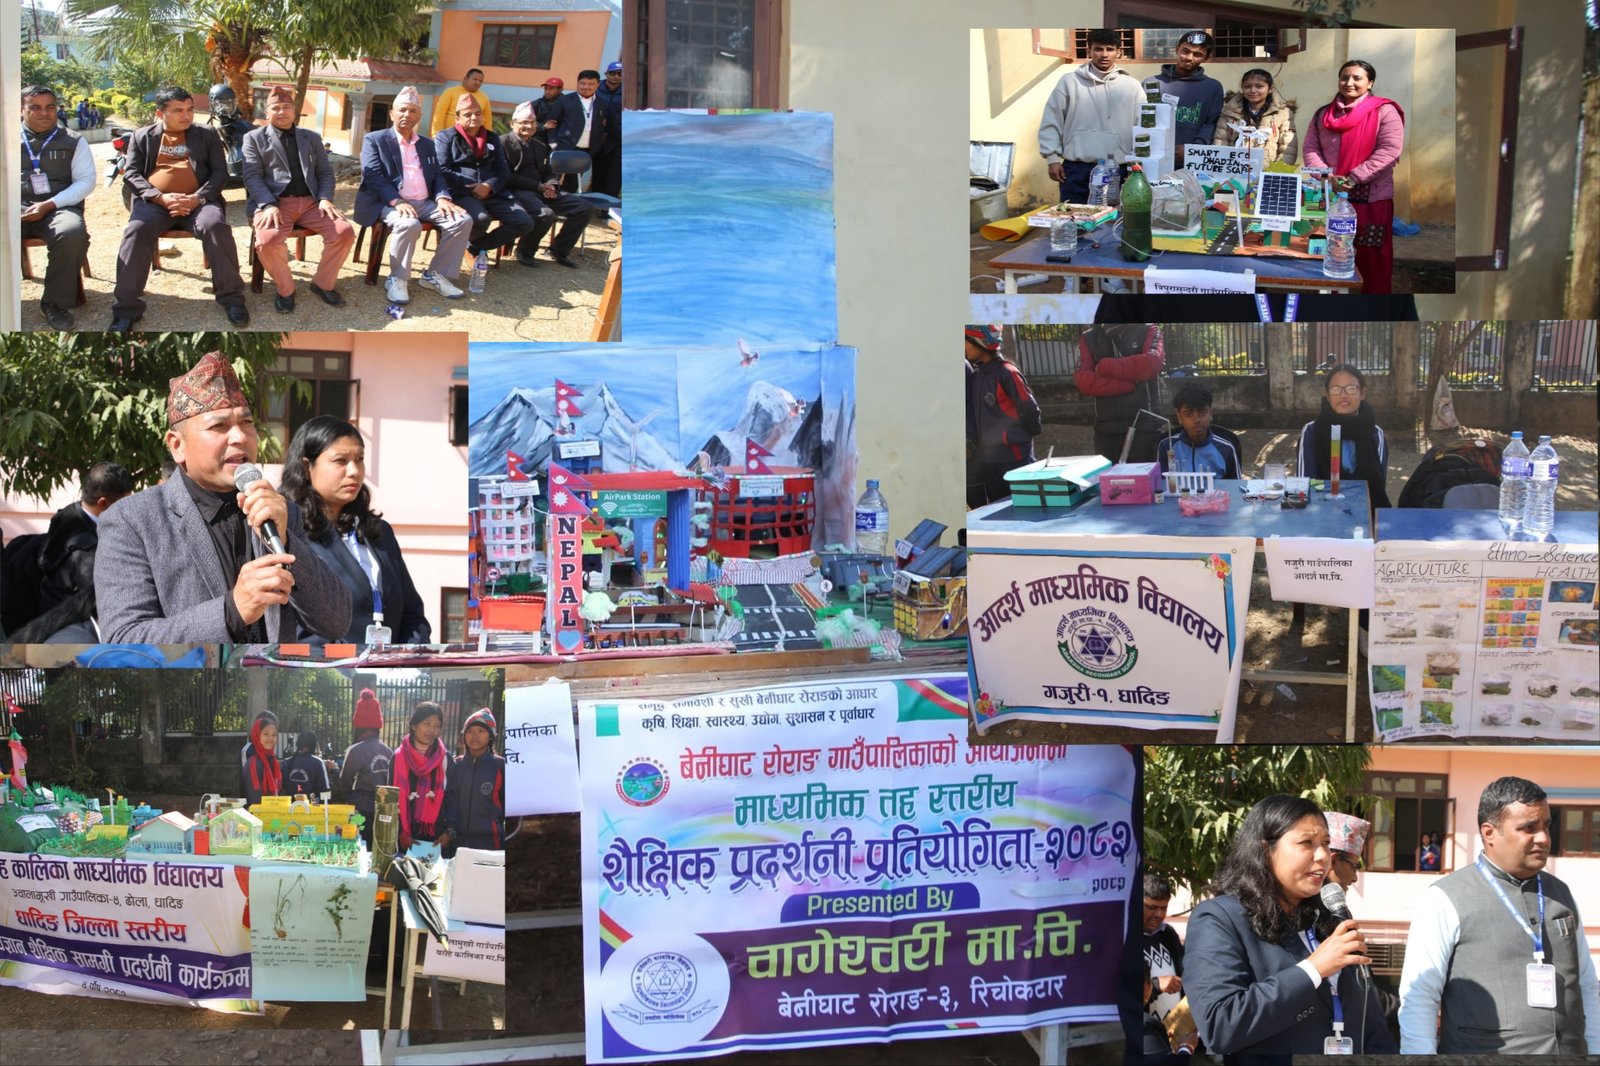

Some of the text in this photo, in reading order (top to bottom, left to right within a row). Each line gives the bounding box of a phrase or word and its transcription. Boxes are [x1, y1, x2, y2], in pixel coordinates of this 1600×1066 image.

[1186, 162, 1224, 173] FUTURE
[1188, 149, 1220, 157] SMART
[557, 516, 578, 627] NEPAL
[1375, 563, 1470, 577] AGRICULTURE
[1535, 565, 1598, 578] HEALTH
[973, 563, 1225, 654] आदर्श माध्यमिक विद्यालय
[1118, 685, 1170, 705] धादिङ
[505, 722, 558, 739] पालिका
[785, 711, 825, 727] सुशासन
[829, 710, 836, 721] र
[680, 745, 756, 780] बेनीघाट
[763, 744, 822, 776] रोराङ
[828, 733, 959, 771] गाउँपालिकाको
[734, 774, 1018, 826] माध्यमिक तह स्तरीय
[10, 853, 70, 882] कालिका
[73, 858, 148, 885] माध्यमिक
[152, 861, 225, 888] विद्यालय
[602, 837, 720, 897] शैक्षिक
[729, 827, 856, 891] प्रदर्शनी
[806, 887, 954, 916] Presented By
[15, 906, 188, 943] धादिङ जिल्ला स्तरीय
[448, 939, 474, 950] लामुखी
[747, 911, 1092, 979] वागेश्वरी मा.वि.
[28, 936, 68, 963] शैक्षिक
[70, 948, 116, 973] सामग्री
[119, 953, 174, 983] प्रदर्शनी
[178, 961, 250, 990] कार्यक्रम
[778, 990, 859, 1019] बेनीघाट
[970, 975, 1067, 1008] रिचोकटार
